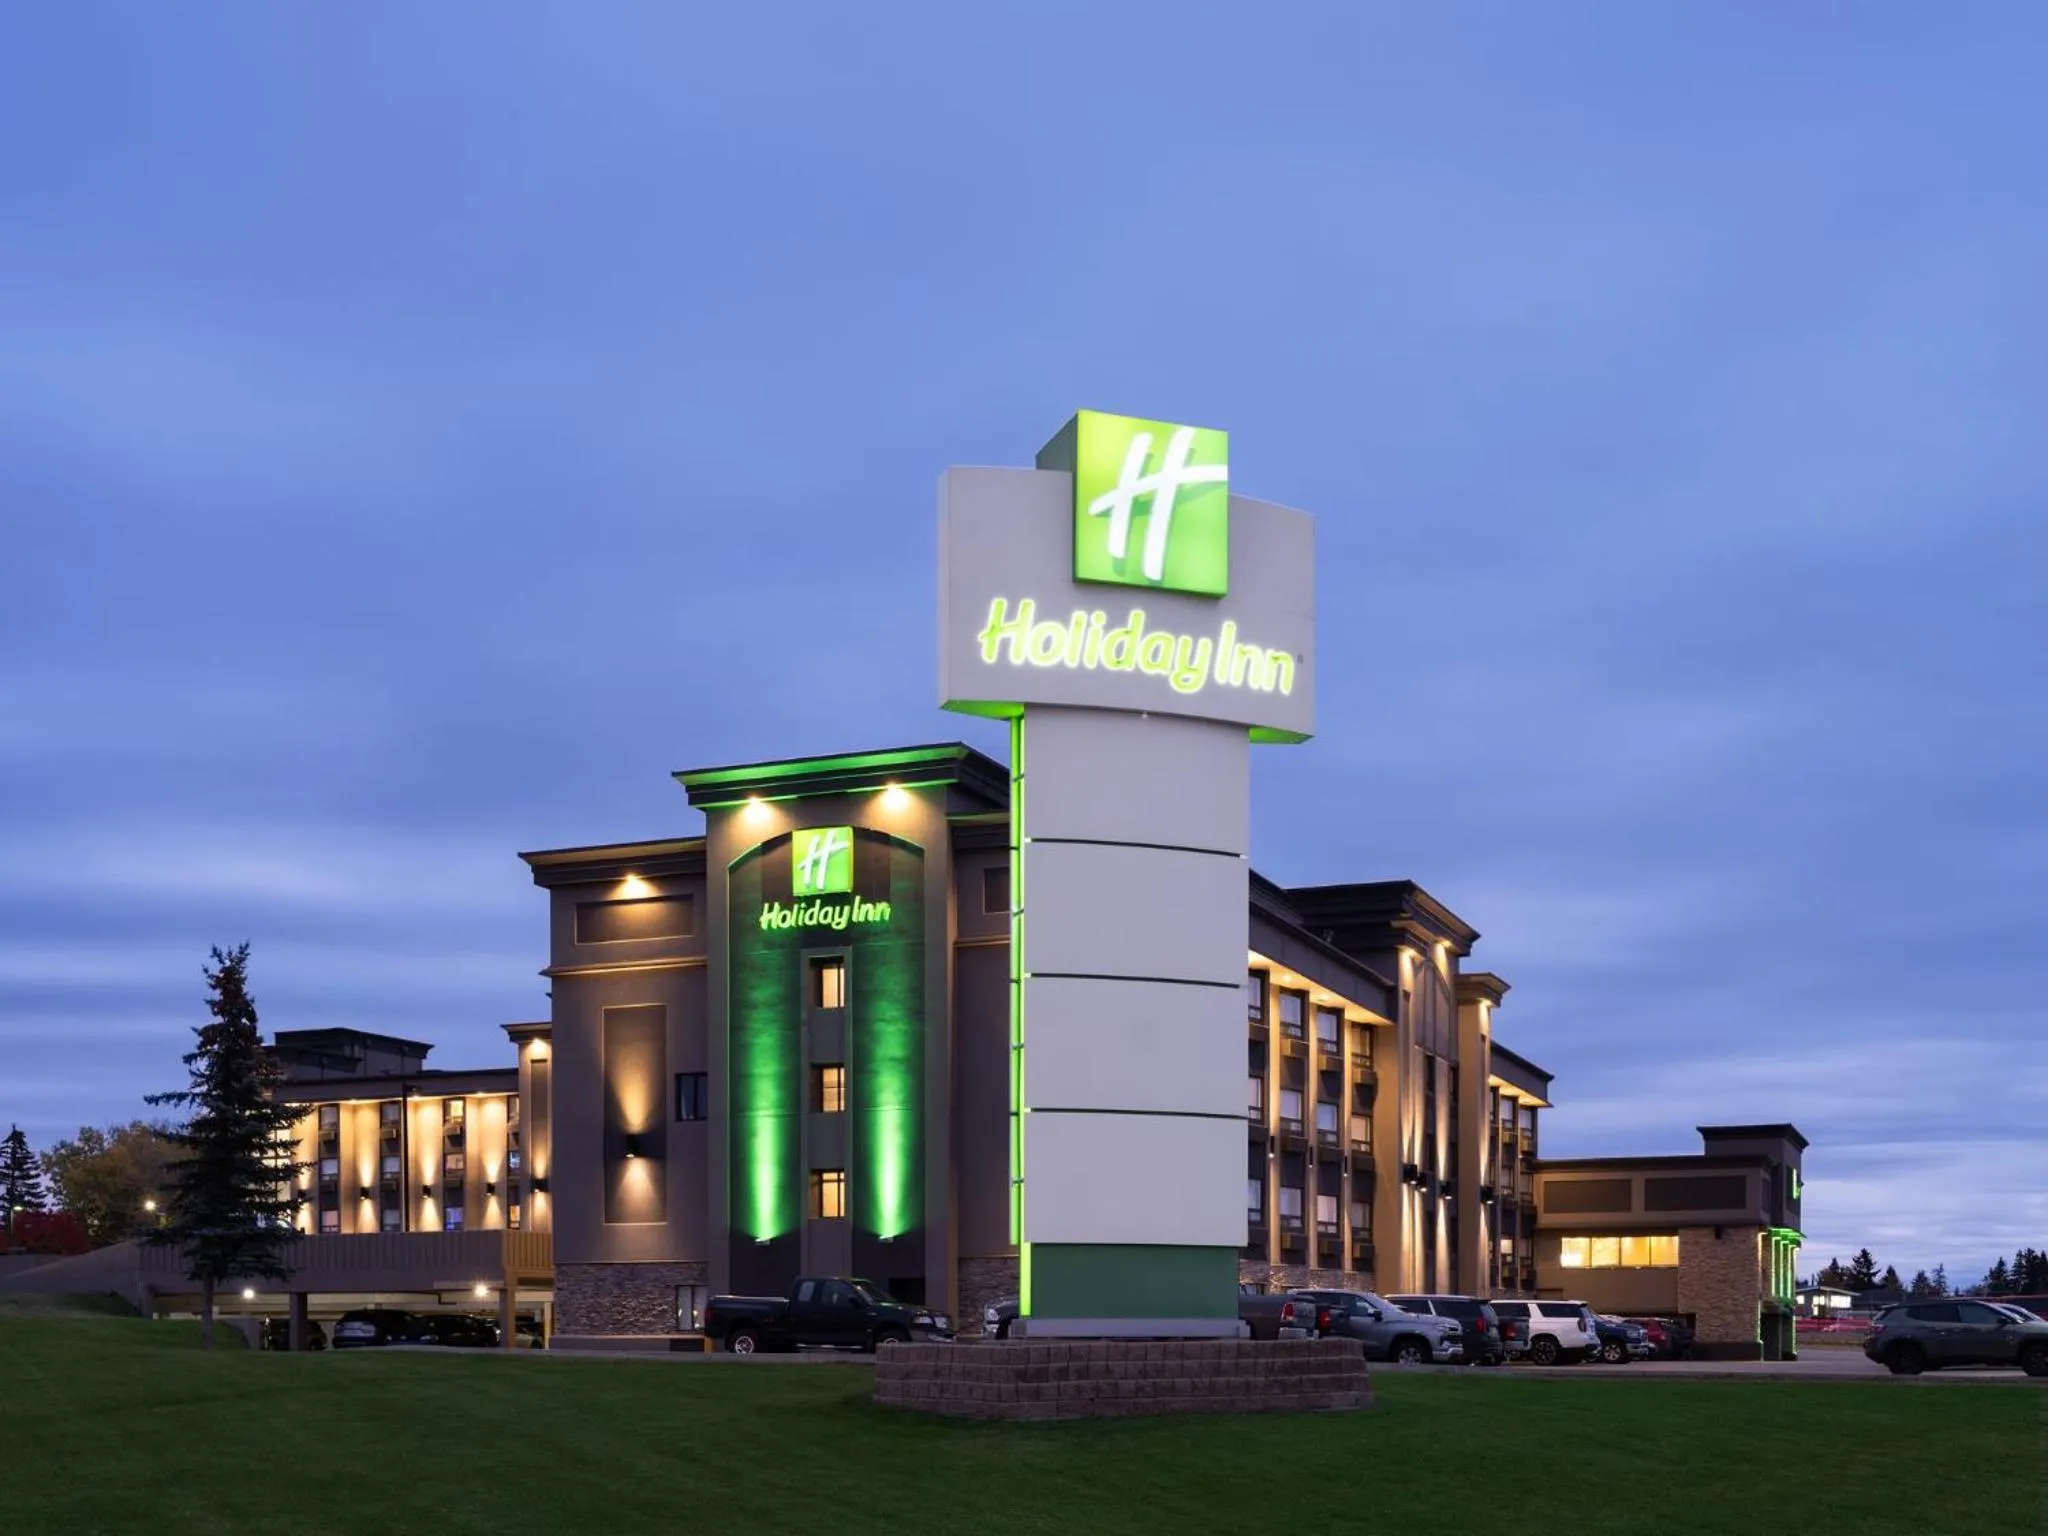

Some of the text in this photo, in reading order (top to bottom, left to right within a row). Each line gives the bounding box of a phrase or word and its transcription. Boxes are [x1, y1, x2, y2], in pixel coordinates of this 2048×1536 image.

[1088, 425, 1228, 580] H
[978, 598, 1294, 695] Holiday Inn
[799, 829, 850, 890] H
[760, 896, 891, 930] Holiday Inn
